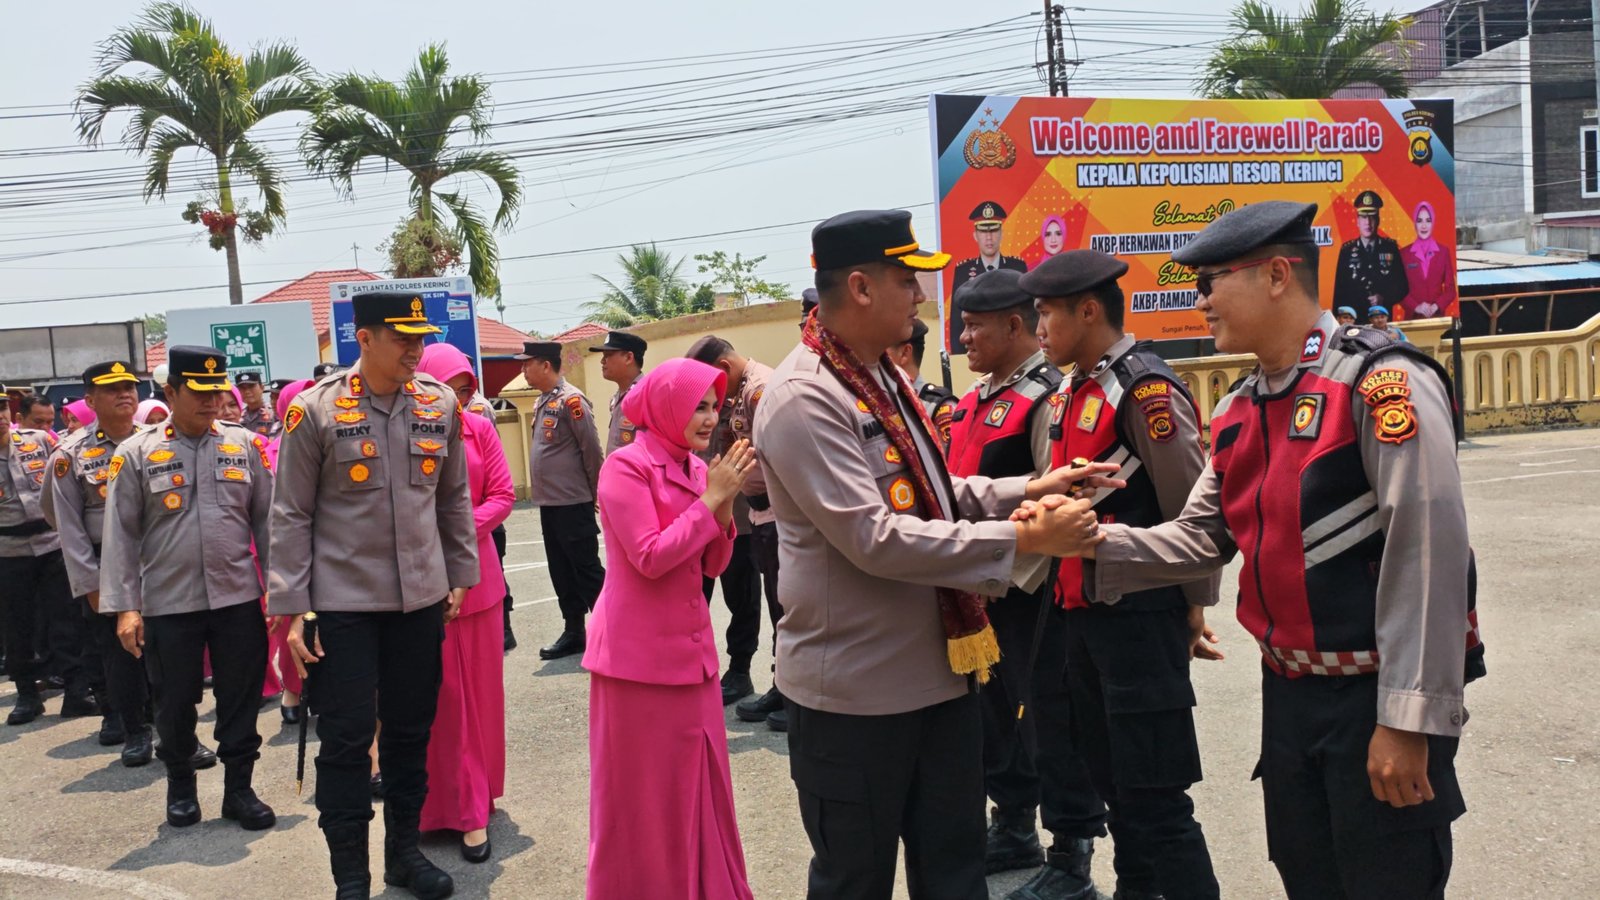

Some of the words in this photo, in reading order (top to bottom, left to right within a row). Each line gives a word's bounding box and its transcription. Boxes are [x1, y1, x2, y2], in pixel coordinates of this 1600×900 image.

[1031, 118, 1150, 153] Welcome
[1154, 119, 1200, 153] and
[1203, 119, 1300, 151] Farewell
[1304, 119, 1382, 151] Parade
[1077, 164, 1137, 187] KEPALA
[1140, 162, 1230, 185] KEPOLISIAN
[1232, 161, 1281, 184] RESOR
[1284, 160, 1342, 182] KERINCI
[1154, 200, 1216, 226] Selamat
[1092, 236, 1117, 253] AKBP
[1119, 234, 1171, 252] HERNAWAN
[1158, 261, 1198, 285] Selam
[353, 285, 394, 293] SATLANTAS
[395, 283, 422, 291] POLRES
[423, 281, 450, 289] KERINCI
[1132, 293, 1158, 311] AKBP
[1160, 290, 1199, 309] RAMADH
[1162, 326, 1183, 334] Sungai
[1363, 371, 1402, 389] POLRES
[1134, 383, 1167, 396] POLRES
[1372, 387, 1405, 401] JAMBI
[336, 425, 371, 438] RIZKY
[412, 423, 445, 434] POLRI
[217, 457, 247, 466] POLRI
